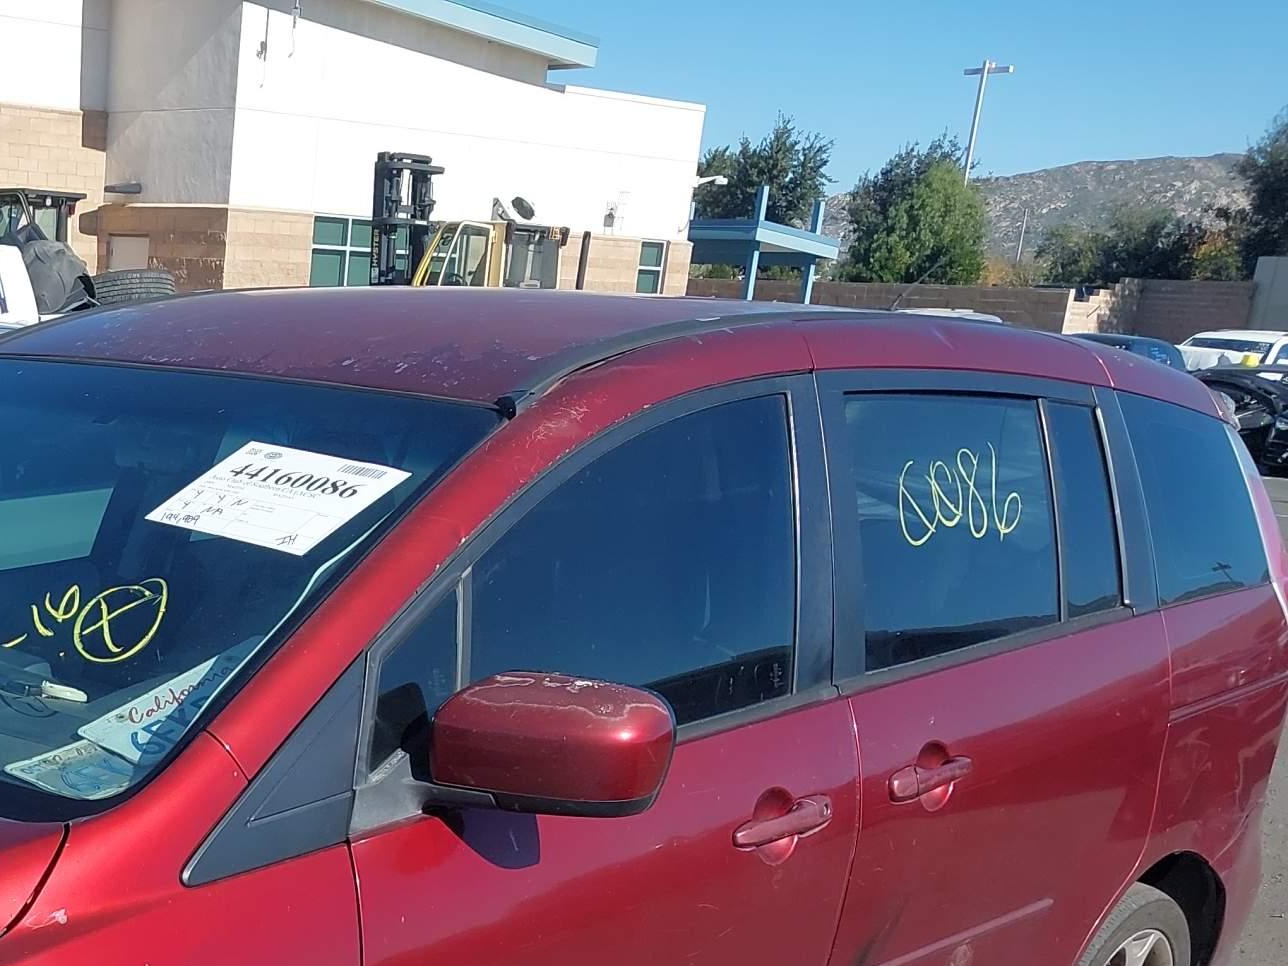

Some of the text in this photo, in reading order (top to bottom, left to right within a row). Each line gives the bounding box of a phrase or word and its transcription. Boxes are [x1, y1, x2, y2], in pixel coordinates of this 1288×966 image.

[372, 229, 380, 267] HYSTER
[229, 463, 367, 499] 44160086
[897, 441, 1023, 548] 0086
[127, 666, 234, 724] California
